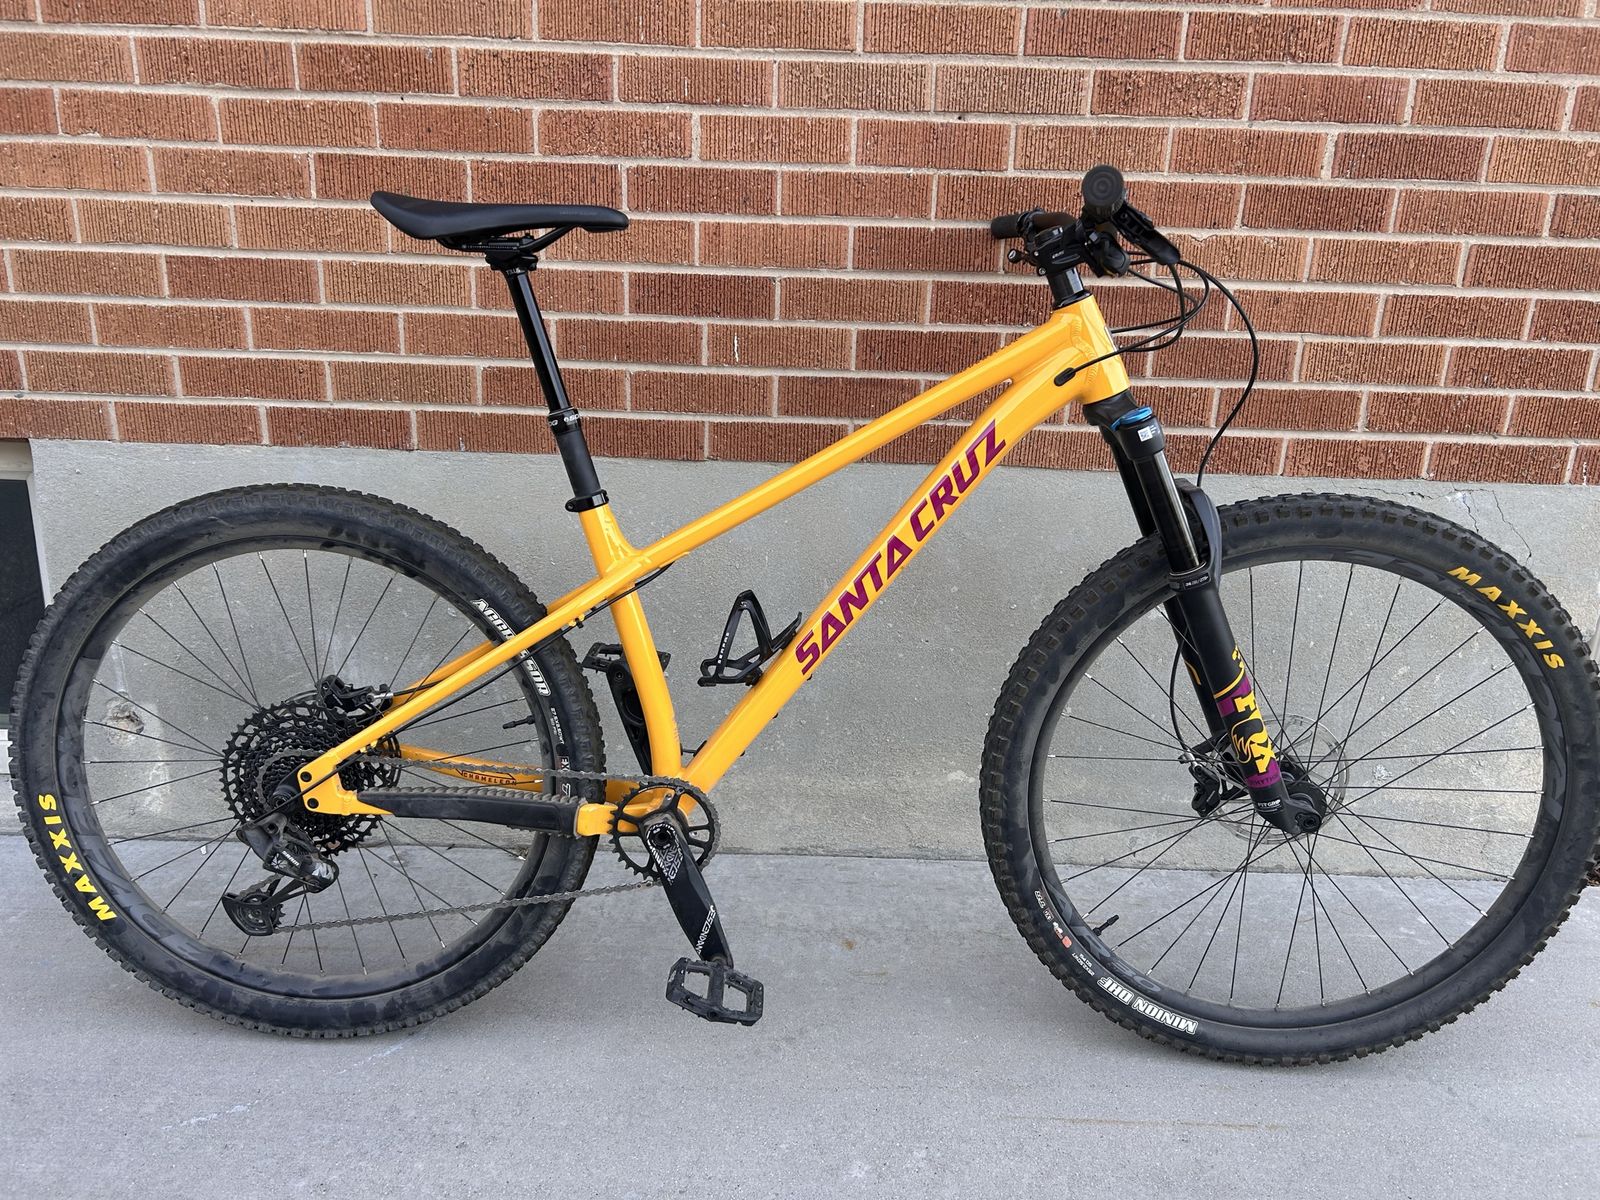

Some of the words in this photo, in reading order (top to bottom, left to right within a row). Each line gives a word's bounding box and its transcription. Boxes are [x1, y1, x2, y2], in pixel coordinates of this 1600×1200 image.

[795, 534, 913, 675] SANTA
[910, 419, 1006, 542] CRUZ
[1446, 566, 1565, 669] MAXXIS
[463, 771, 517, 786] CHAMELEON
[38, 793, 118, 921] MAXXIS
[1097, 977, 1134, 1005] DHF
[1132, 997, 1198, 1034] MINION
